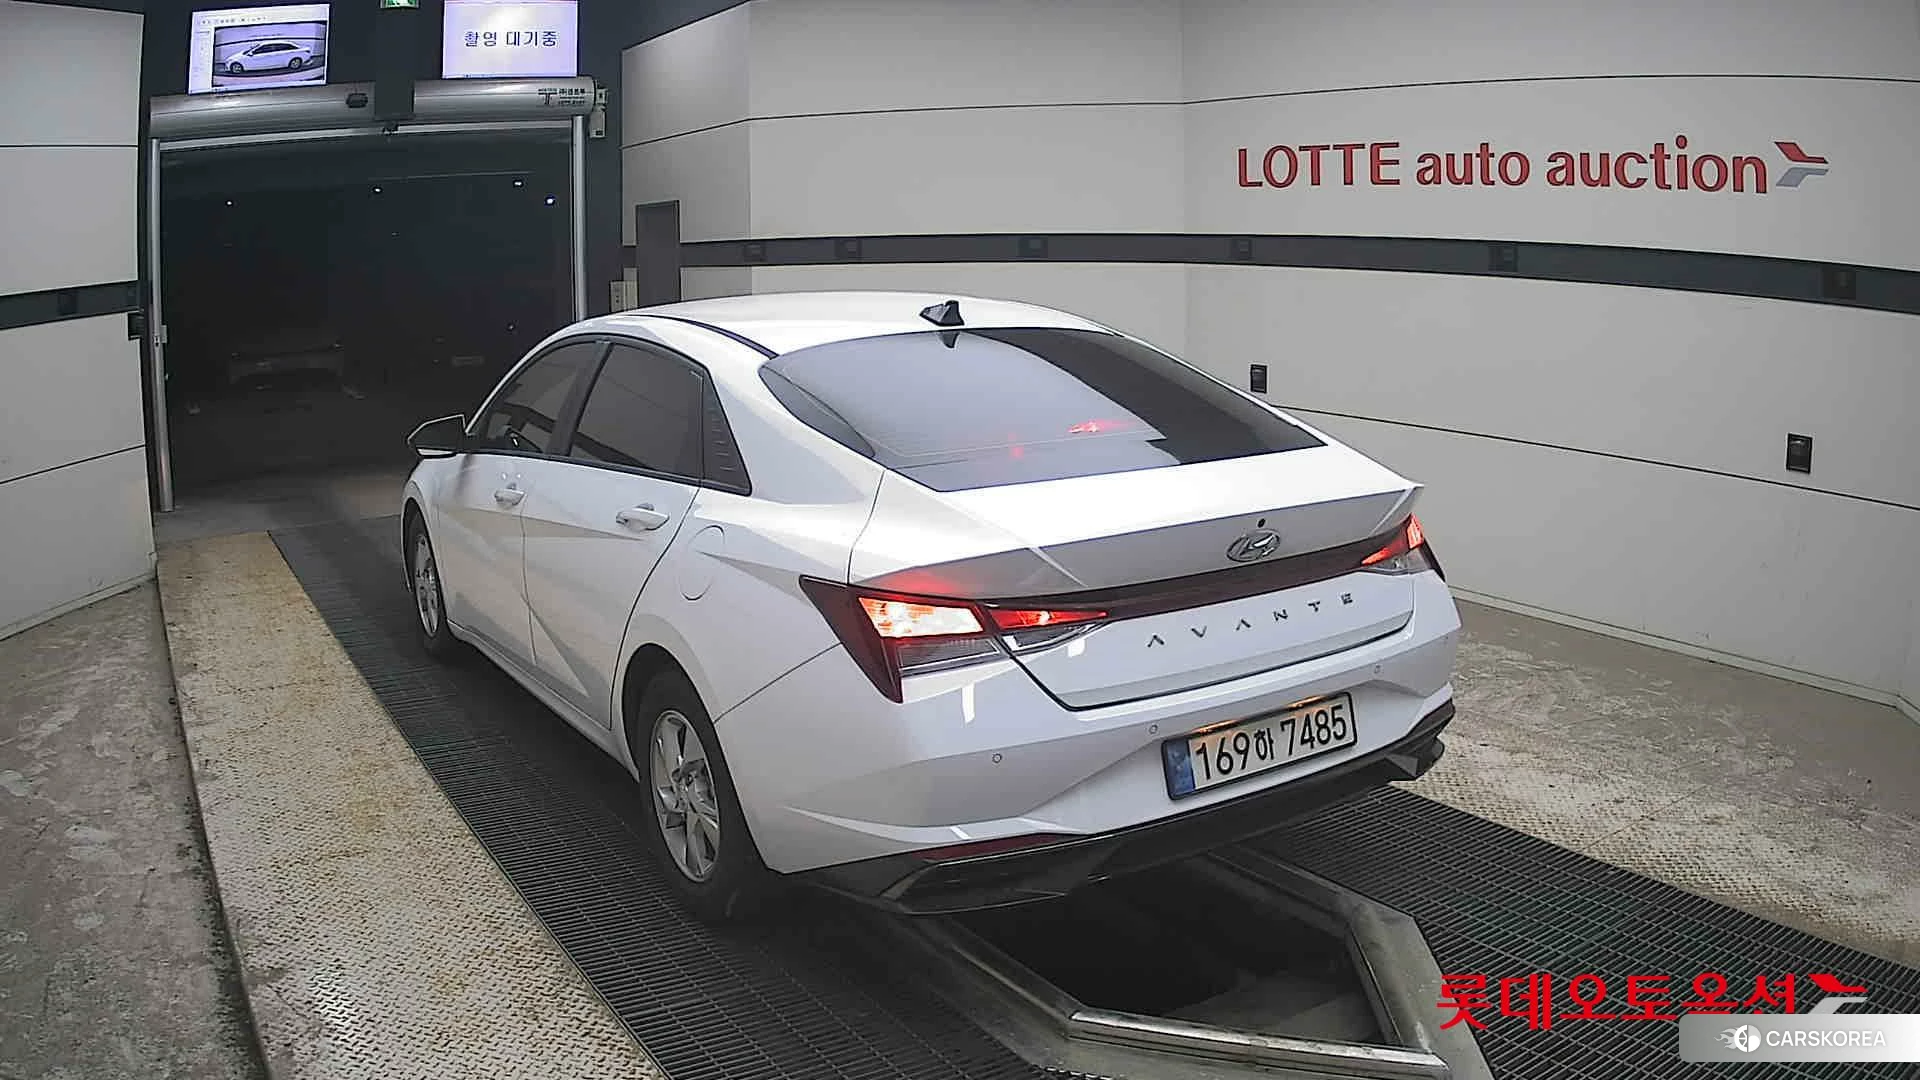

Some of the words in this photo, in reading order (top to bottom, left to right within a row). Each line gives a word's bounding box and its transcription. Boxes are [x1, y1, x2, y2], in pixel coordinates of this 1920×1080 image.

[464, 31, 497, 47] 촬영
[506, 31, 558, 47] 대기중
[1236, 141, 1400, 188] LOTTE
[1416, 140, 1530, 187] auto
[1546, 134, 1767, 194] auction
[1147, 593, 1353, 647] AVANTE
[1196, 728, 1275, 780] 169하
[1280, 704, 1347, 756] 7485
